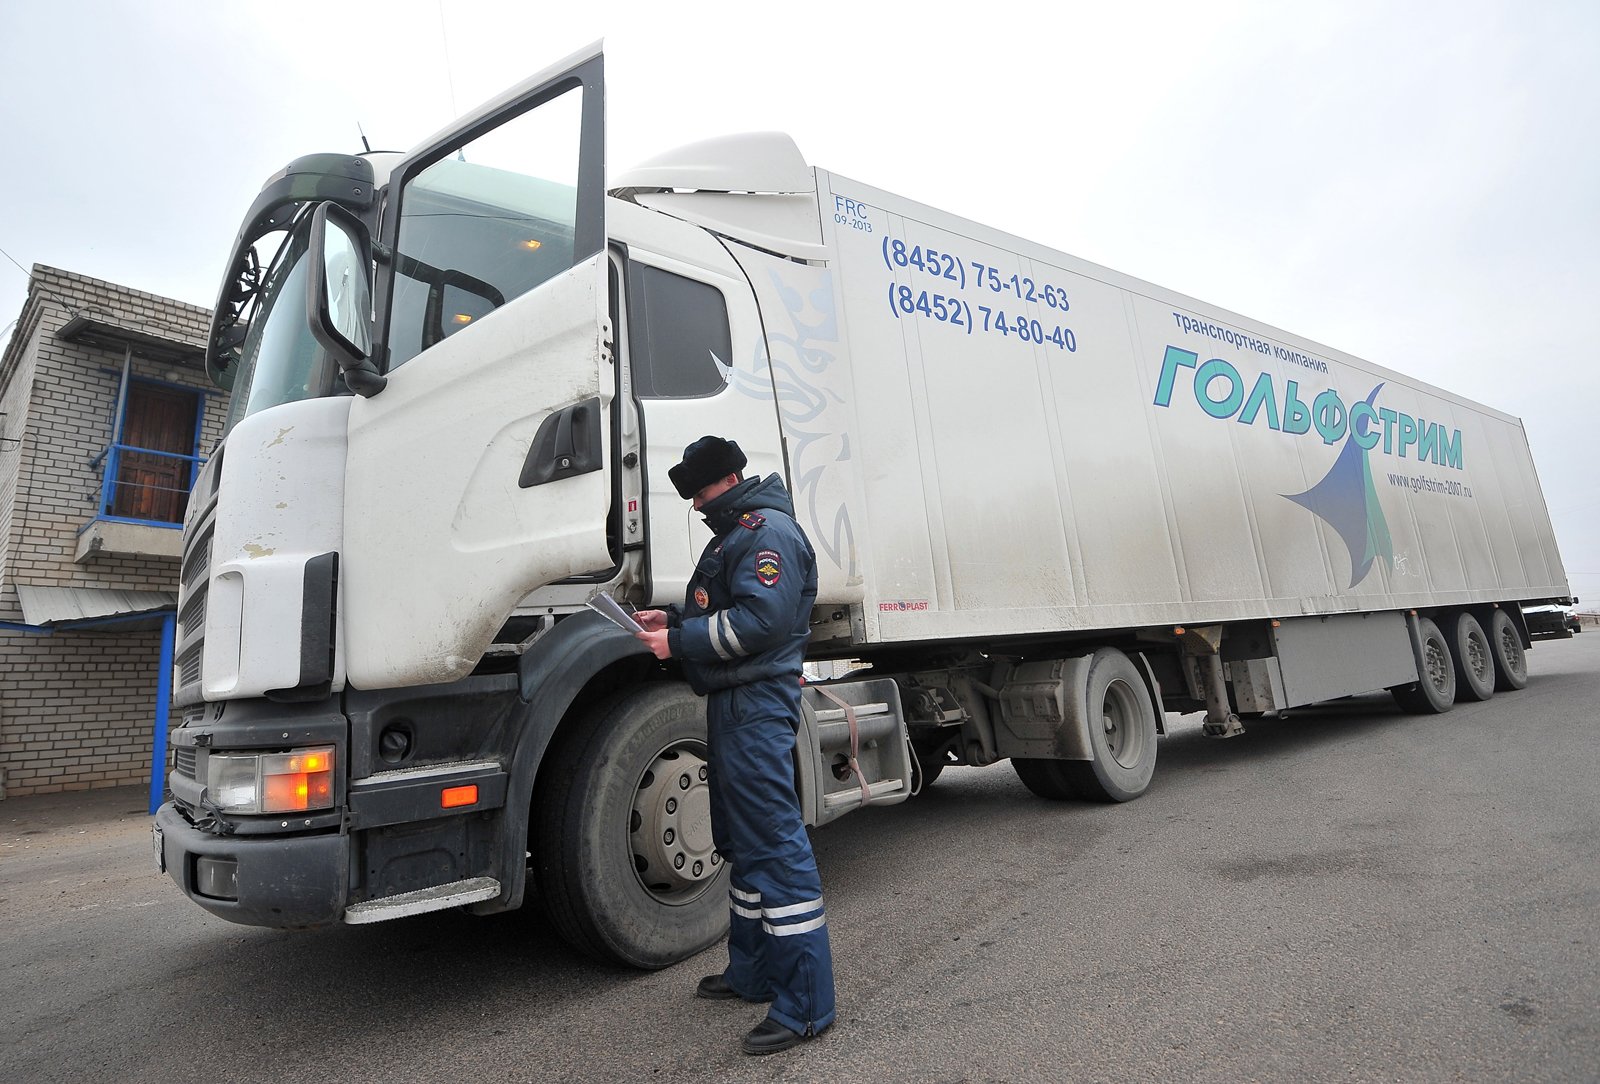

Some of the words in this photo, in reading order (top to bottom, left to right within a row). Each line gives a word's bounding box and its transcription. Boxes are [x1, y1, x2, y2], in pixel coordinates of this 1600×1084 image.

[834, 196, 868, 220] FRC
[834, 213, 873, 233] 09-2013
[882, 236, 966, 290] (8452)
[971, 262, 1070, 312] 75-12-63
[888, 282, 973, 334] (8452)
[978, 305, 1077, 353] 74-80-40
[1172, 312, 1272, 356] транспортная
[1274, 345, 1329, 375] компания
[1153, 344, 1463, 470] ГОЛЬФСТРИМ
[1387, 472, 1473, 498] www.golfstrim-2007.ru
